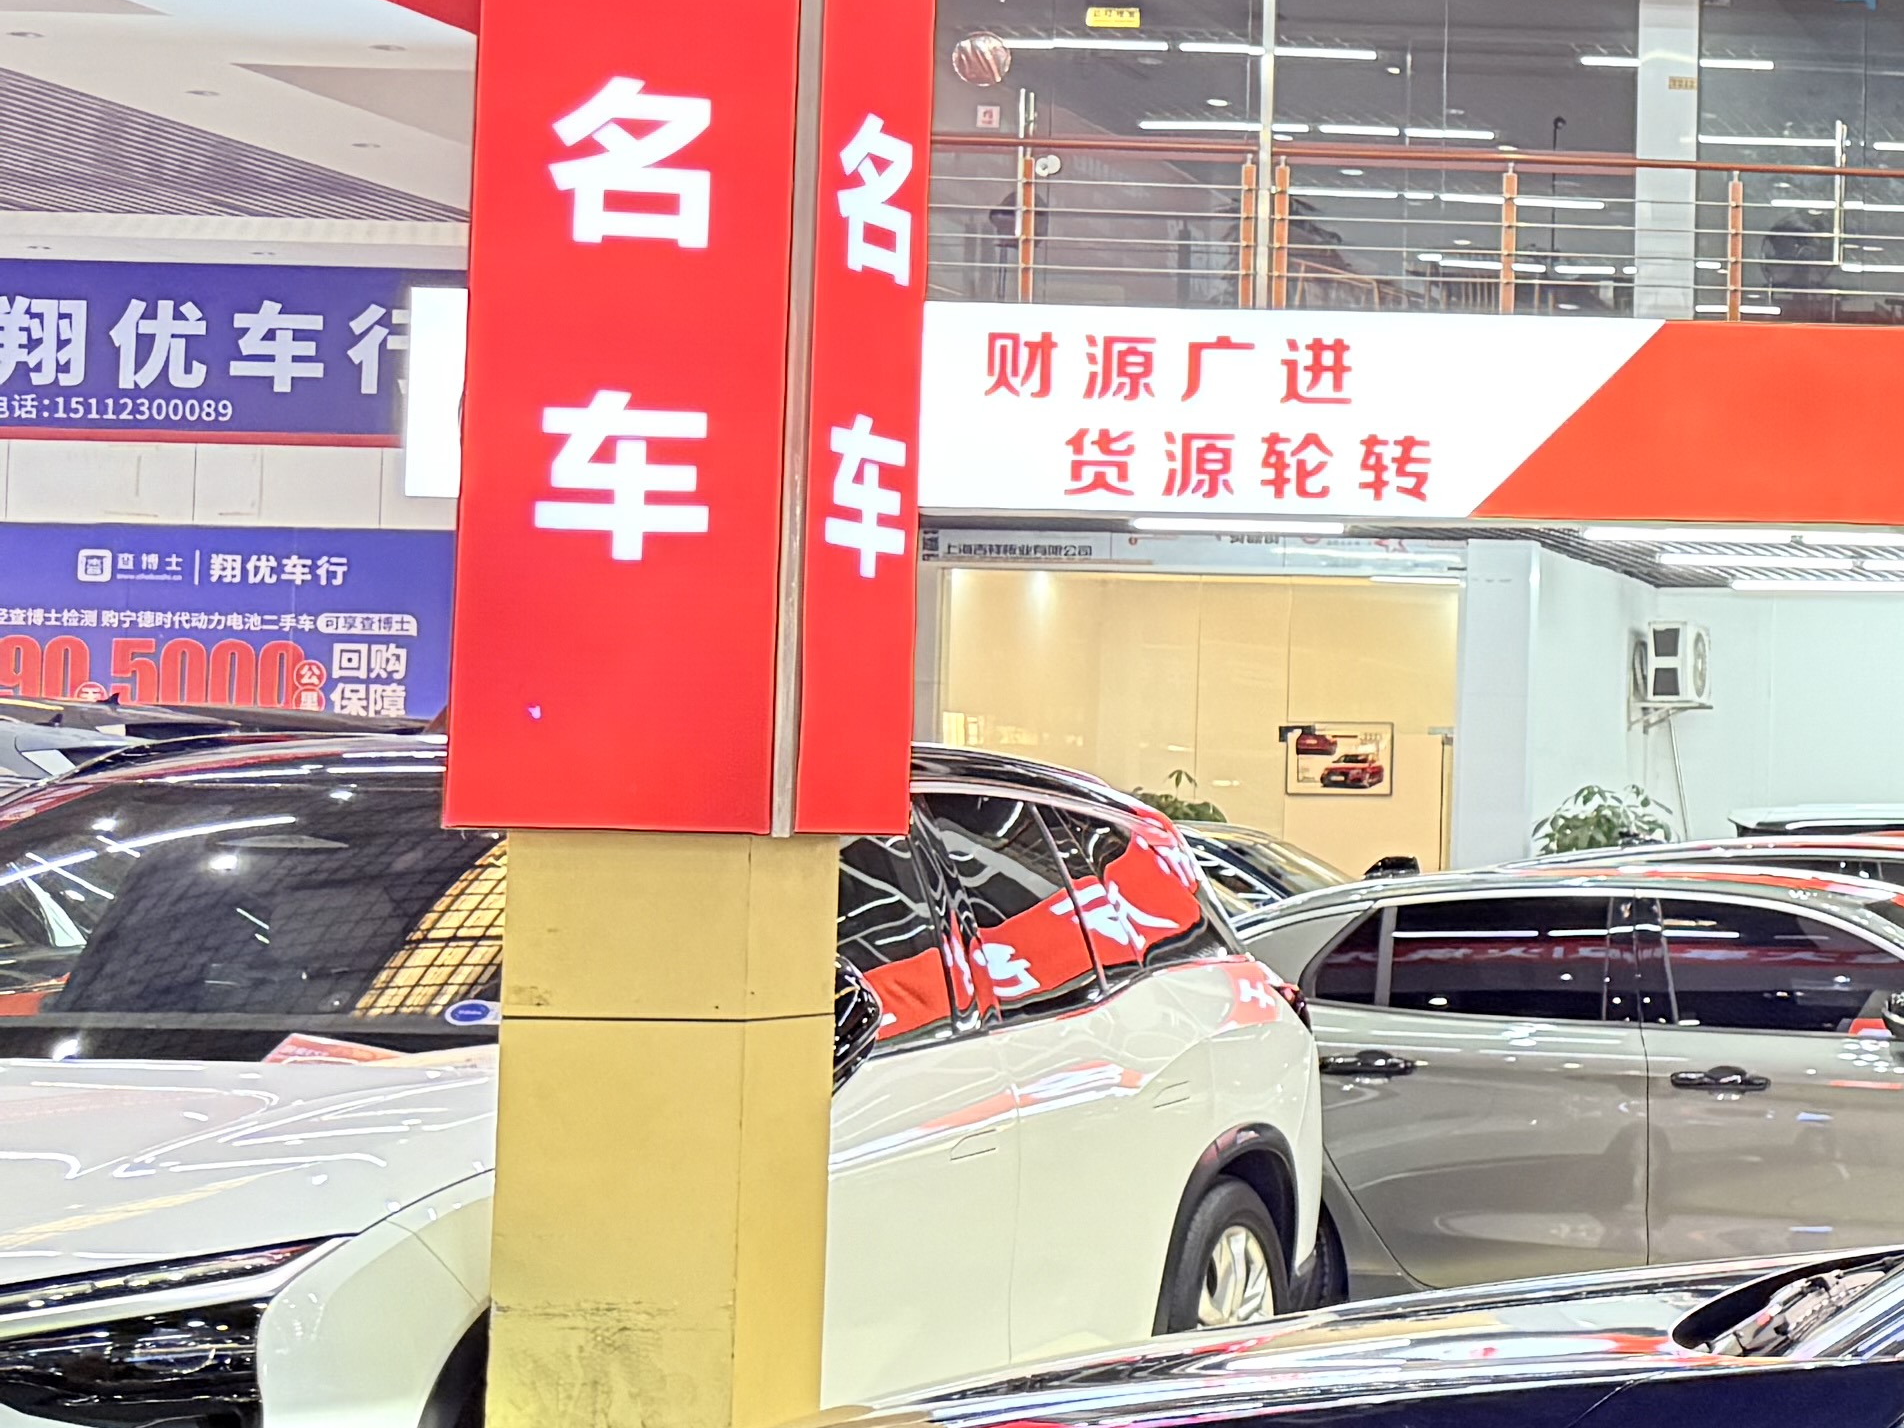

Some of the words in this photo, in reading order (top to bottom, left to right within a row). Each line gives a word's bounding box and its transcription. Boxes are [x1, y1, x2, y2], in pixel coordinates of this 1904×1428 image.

[0, 295, 410, 395] 翔优车行
[985, 331, 1352, 404] 财源广进
[1063, 427, 1432, 502] 货源轮转
[117, 552, 184, 571] 查博士
[209, 554, 349, 586] 翔优车行
[332, 643, 407, 680] 回购
[331, 683, 407, 718] 保障
